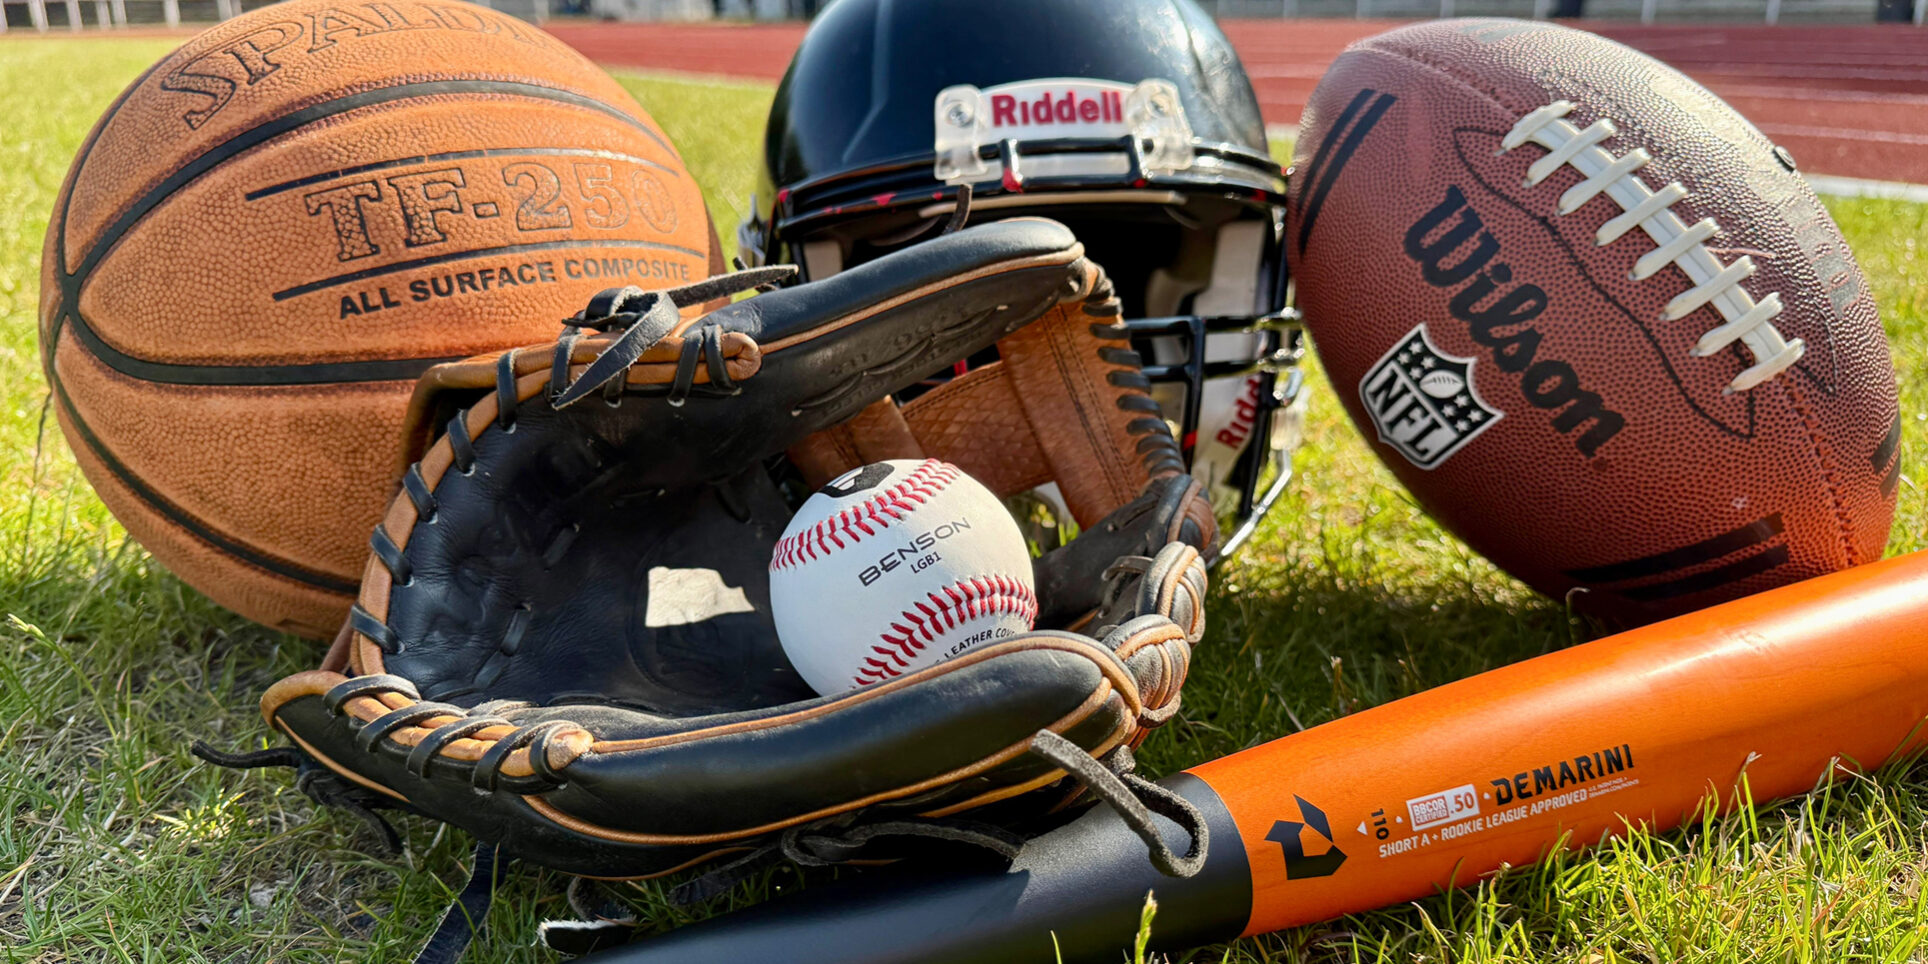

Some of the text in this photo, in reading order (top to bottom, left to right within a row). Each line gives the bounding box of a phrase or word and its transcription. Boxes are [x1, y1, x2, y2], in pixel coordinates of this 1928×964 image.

[990, 91, 1123, 127] Riddell
[303, 161, 679, 262] TF-250
[339, 257, 691, 320] ALL SURFACE COMPOSITE
[1403, 184, 1626, 459] Wilson
[1368, 368, 1444, 458] NFL
[858, 517, 972, 587] BENSON
[910, 551, 942, 574] LGB1
[944, 628, 1016, 659] LEATHER COV
[1490, 744, 1634, 806] DEMARINI
[1371, 808, 1390, 840] 110
[1379, 836, 1420, 858] SHORT
[1421, 833, 1431, 846] A
[1441, 818, 1484, 841] ROOKIE
[1486, 805, 1528, 828] LEAGUE
[1530, 788, 1588, 815] APPROVED
[1413, 799, 1446, 816] BBCOR
